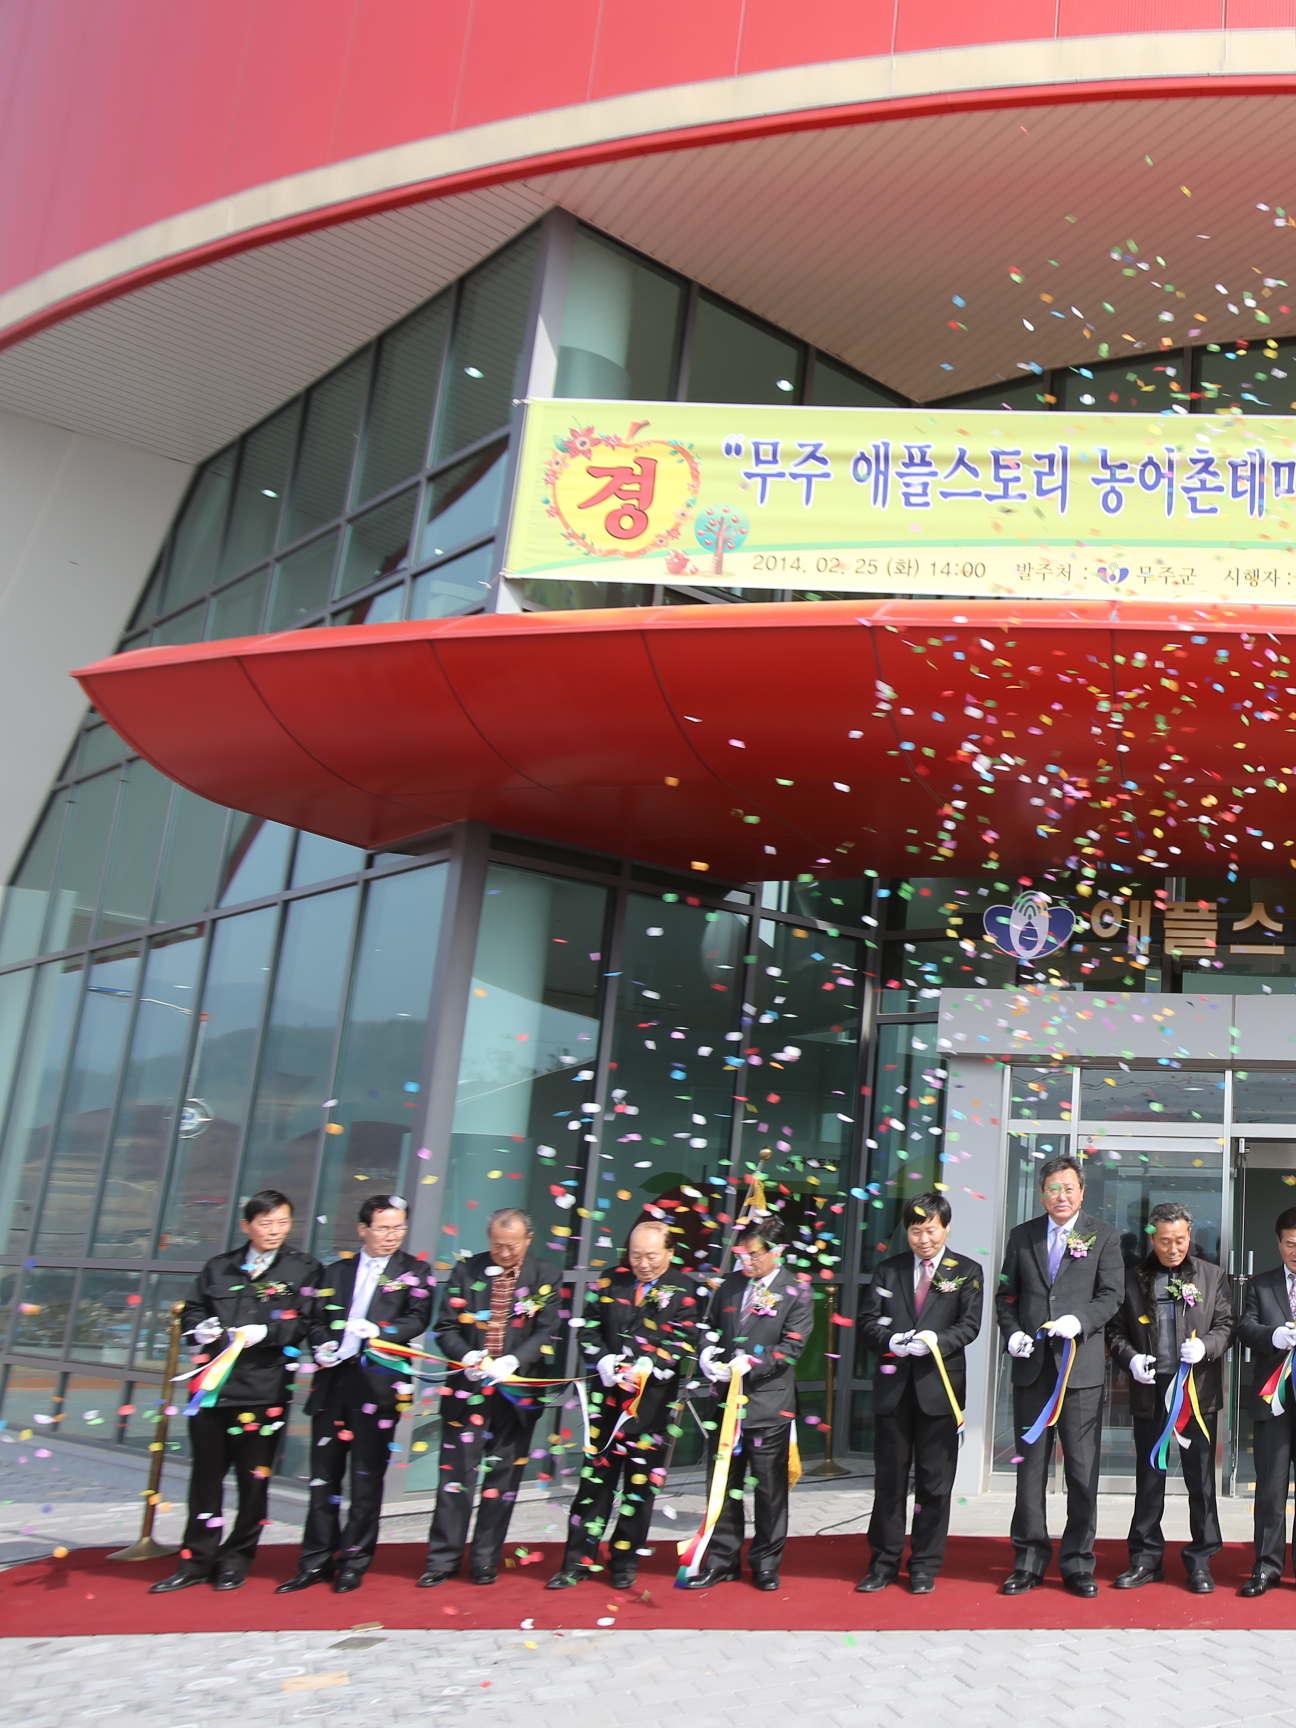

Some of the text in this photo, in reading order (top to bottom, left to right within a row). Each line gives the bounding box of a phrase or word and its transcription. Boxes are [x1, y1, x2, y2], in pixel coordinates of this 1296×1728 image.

[577, 456, 658, 540] 경
[851, 440, 1071, 514] 애플스토리
[854, 559, 879, 576] 25
[886, 559, 920, 579] (화)
[929, 561, 987, 580] 14:00
[1136, 565, 1198, 586] 무주군
